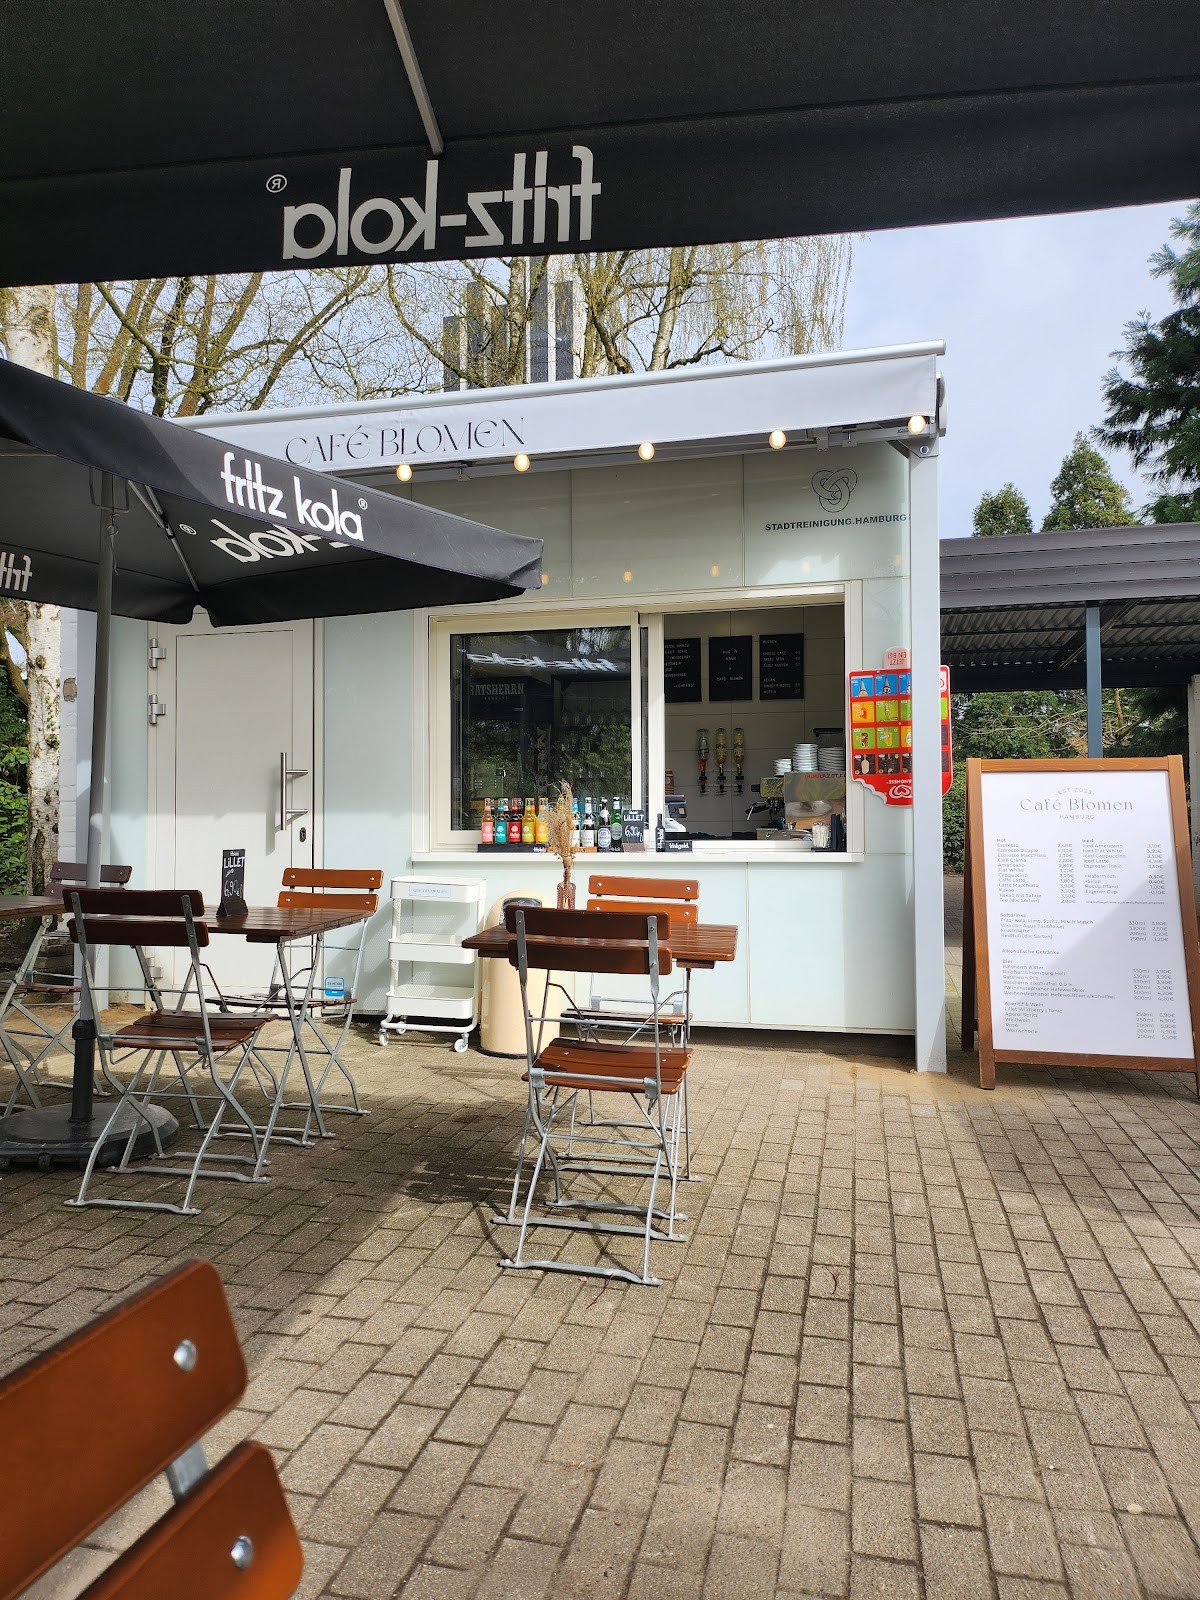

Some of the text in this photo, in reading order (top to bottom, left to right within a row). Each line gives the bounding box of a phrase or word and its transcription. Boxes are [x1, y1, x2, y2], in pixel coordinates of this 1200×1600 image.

[285, 417, 525, 464] CAFÉ BLOMEN
[221, 452, 365, 542] fritz kola
[765, 514, 907, 531] STADTREINIGUNG.HAMBURG
[1020, 798, 1133, 810] Café Blomen
